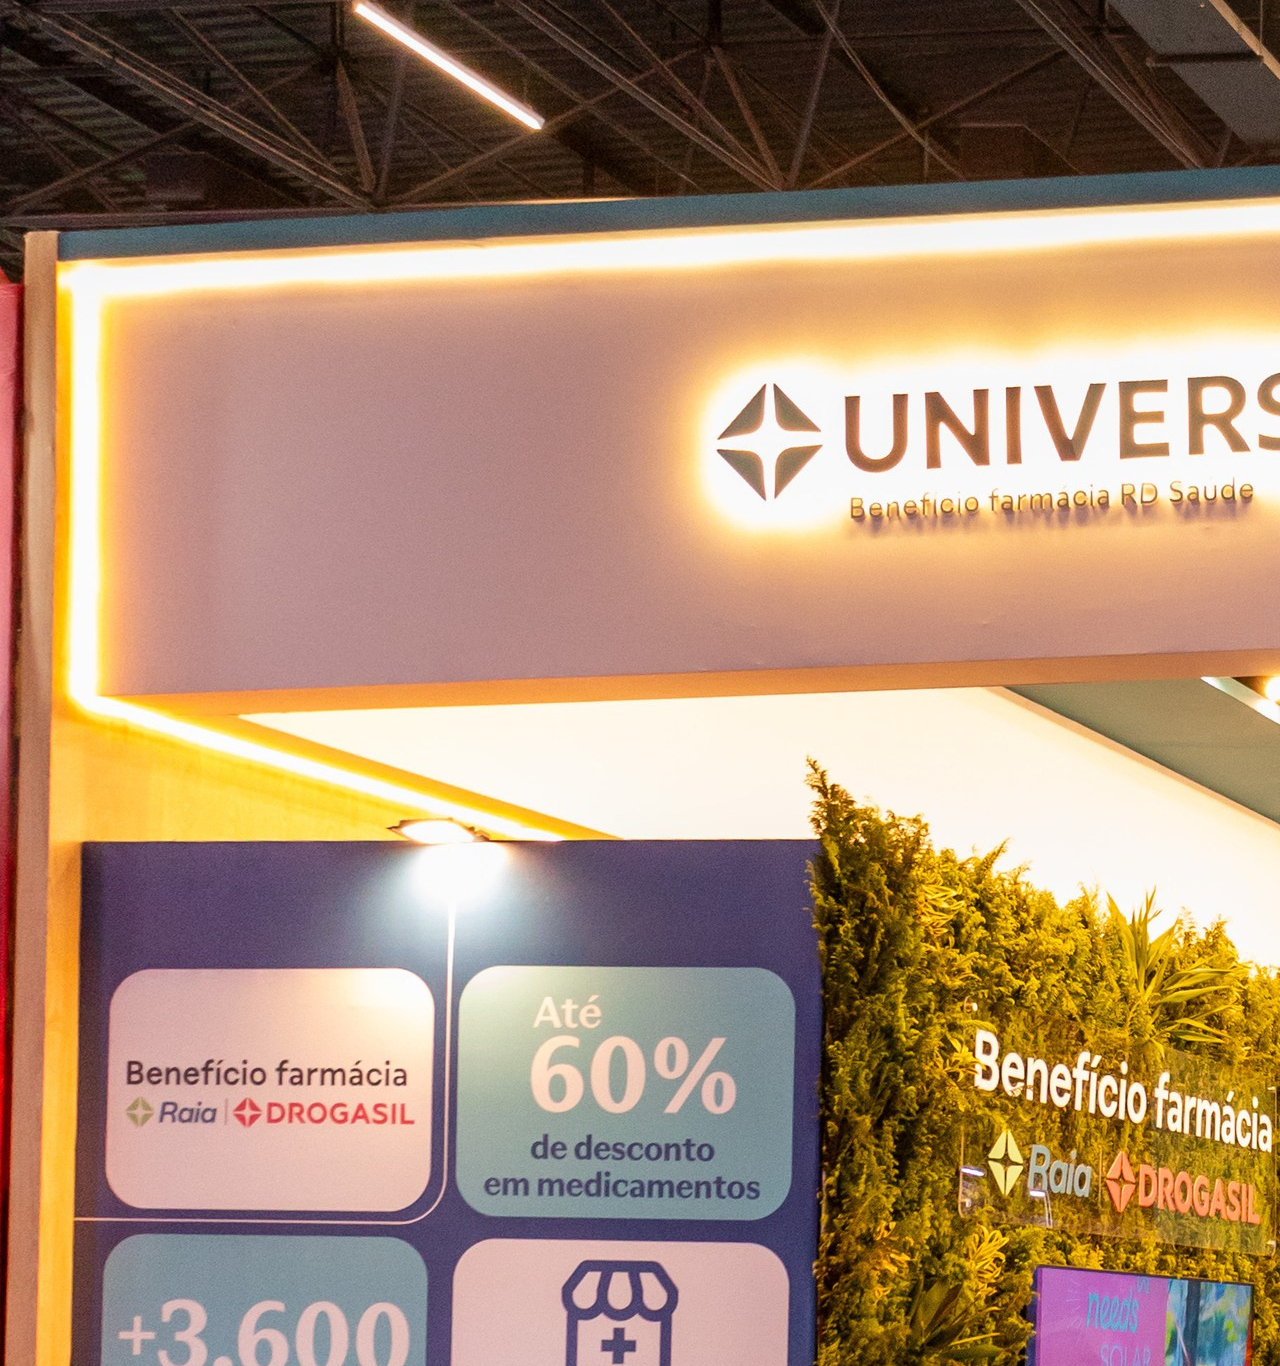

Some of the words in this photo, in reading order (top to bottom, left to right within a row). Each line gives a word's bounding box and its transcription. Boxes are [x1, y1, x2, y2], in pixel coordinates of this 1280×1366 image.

[1121, 482, 1158, 506] RD
[533, 996, 602, 1029] Até
[126, 1060, 267, 1087] Benefício
[275, 1060, 409, 1088] farmácia
[530, 1035, 738, 1115] 60%
[974, 1029, 1147, 1124] Benefício
[1154, 1071, 1273, 1152] farmácia
[158, 1101, 217, 1125] Raia
[266, 1102, 415, 1126] DROGASIL
[530, 1135, 568, 1161] de
[574, 1136, 716, 1164] desconto
[483, 1177, 531, 1198] em
[537, 1171, 761, 1201] medicamentos
[1028, 1144, 1092, 1198] Raia
[1138, 1164, 1261, 1225] DROGASIL
[1086, 1288, 1139, 1333] needs
